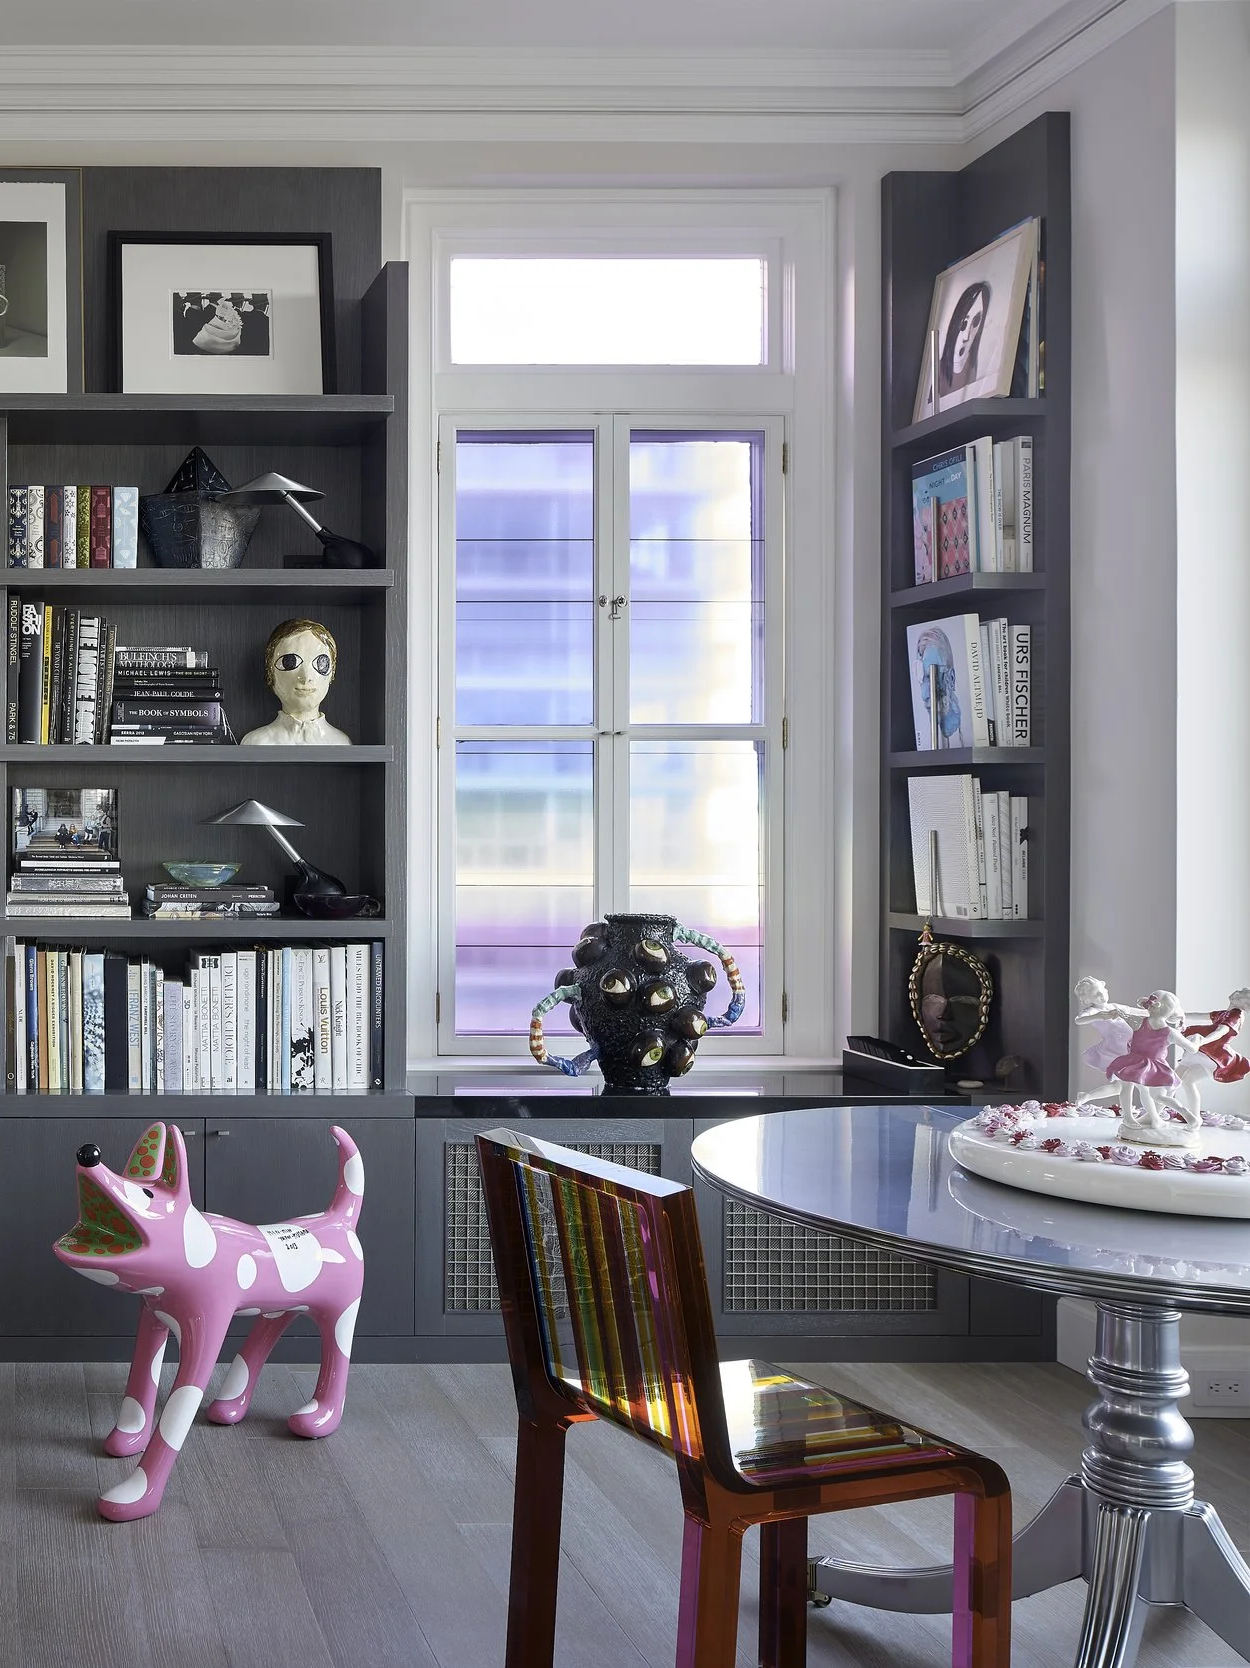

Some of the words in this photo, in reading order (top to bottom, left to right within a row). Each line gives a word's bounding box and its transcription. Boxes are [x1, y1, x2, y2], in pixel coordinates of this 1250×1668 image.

[950, 471, 962, 482] DAY
[1022, 457, 1031, 488] PARIS
[1023, 490, 1031, 544] MAGNUM
[79, 617, 98, 647] THE
[9, 633, 17, 665] STINGEL
[120, 652, 177, 661] BULFINCH'S
[970, 642, 978, 672] DAVID
[1016, 633, 1029, 664] URS
[77, 649, 98, 699] MOVIE
[973, 674, 984, 719] ALTMEJD
[1015, 670, 1029, 739] FISCHER
[75, 700, 95, 745] BOOK
[169, 709, 209, 717] SYMBOLS
[9, 731, 15, 740] 75
[129, 992, 139, 1021] FRANZ
[224, 965, 234, 1019] DEALER'S
[320, 987, 329, 1015] Louis
[335, 1000, 343, 1015] Nick
[129, 1023, 139, 1049] WEST
[321, 1017, 329, 1054] Vuitton
[333, 1015, 343, 1037] Knight
[224, 1020, 234, 1065] CHOICE
